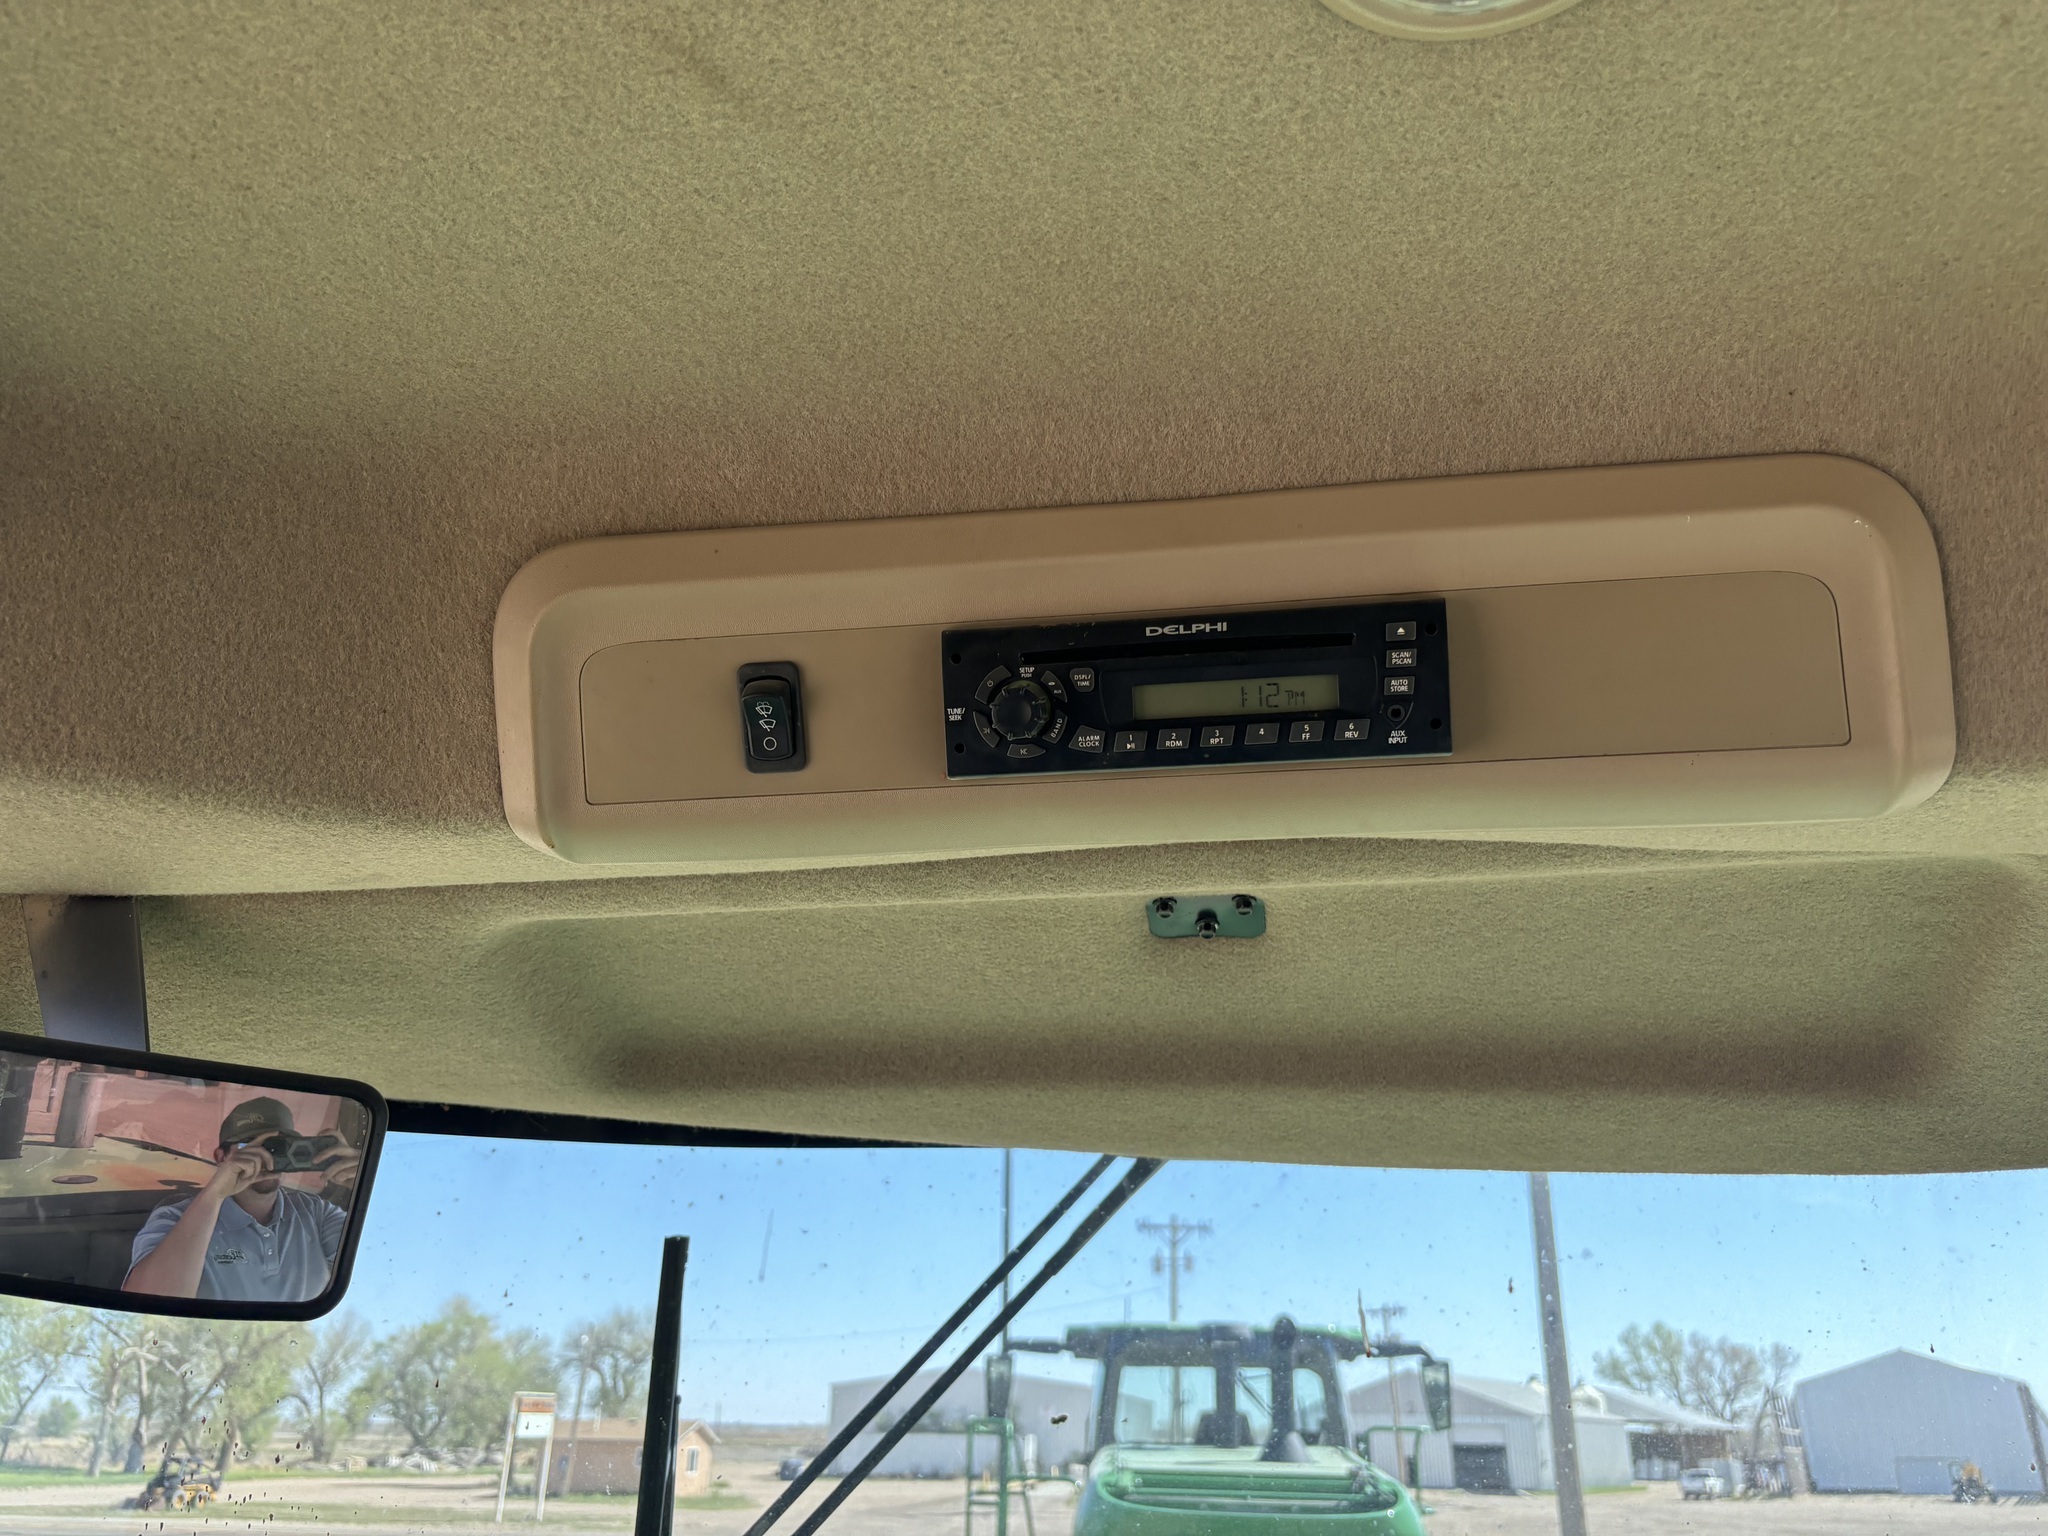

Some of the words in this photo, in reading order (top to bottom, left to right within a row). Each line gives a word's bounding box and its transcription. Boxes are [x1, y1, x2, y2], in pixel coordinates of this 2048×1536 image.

[1145, 622, 1228, 637] DELPHI
[1392, 651, 1412, 659] SCAN/
[1285, 690, 1306, 706] PM
[1051, 718, 1063, 738] BAND
[1388, 736, 1408, 744] INPUT
